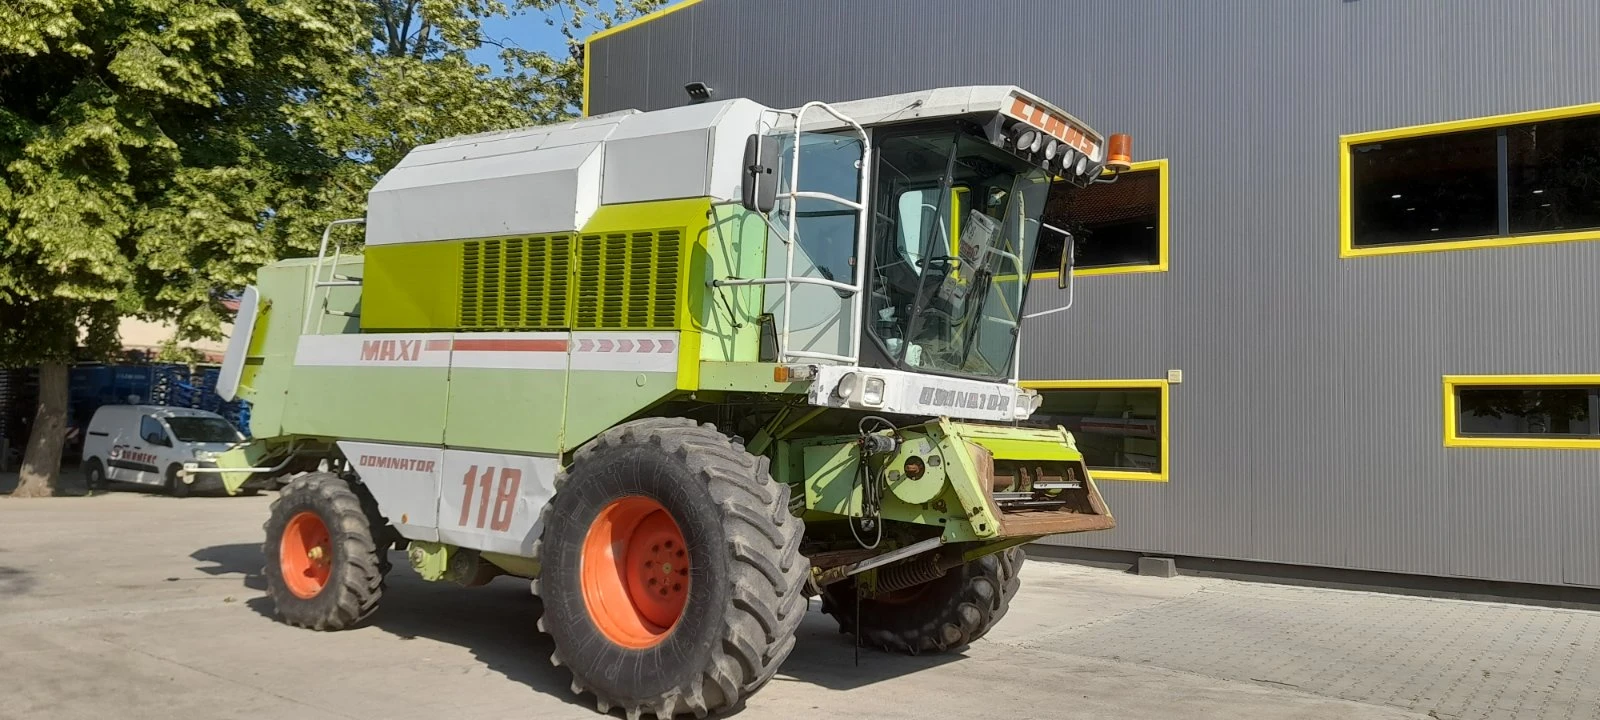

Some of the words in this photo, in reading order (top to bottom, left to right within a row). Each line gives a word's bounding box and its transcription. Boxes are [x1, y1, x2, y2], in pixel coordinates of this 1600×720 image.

[1011, 97, 1094, 155] CLAAS
[360, 339, 421, 361] MAXI
[360, 455, 435, 473] DOMINATOR
[458, 465, 522, 532] 118
